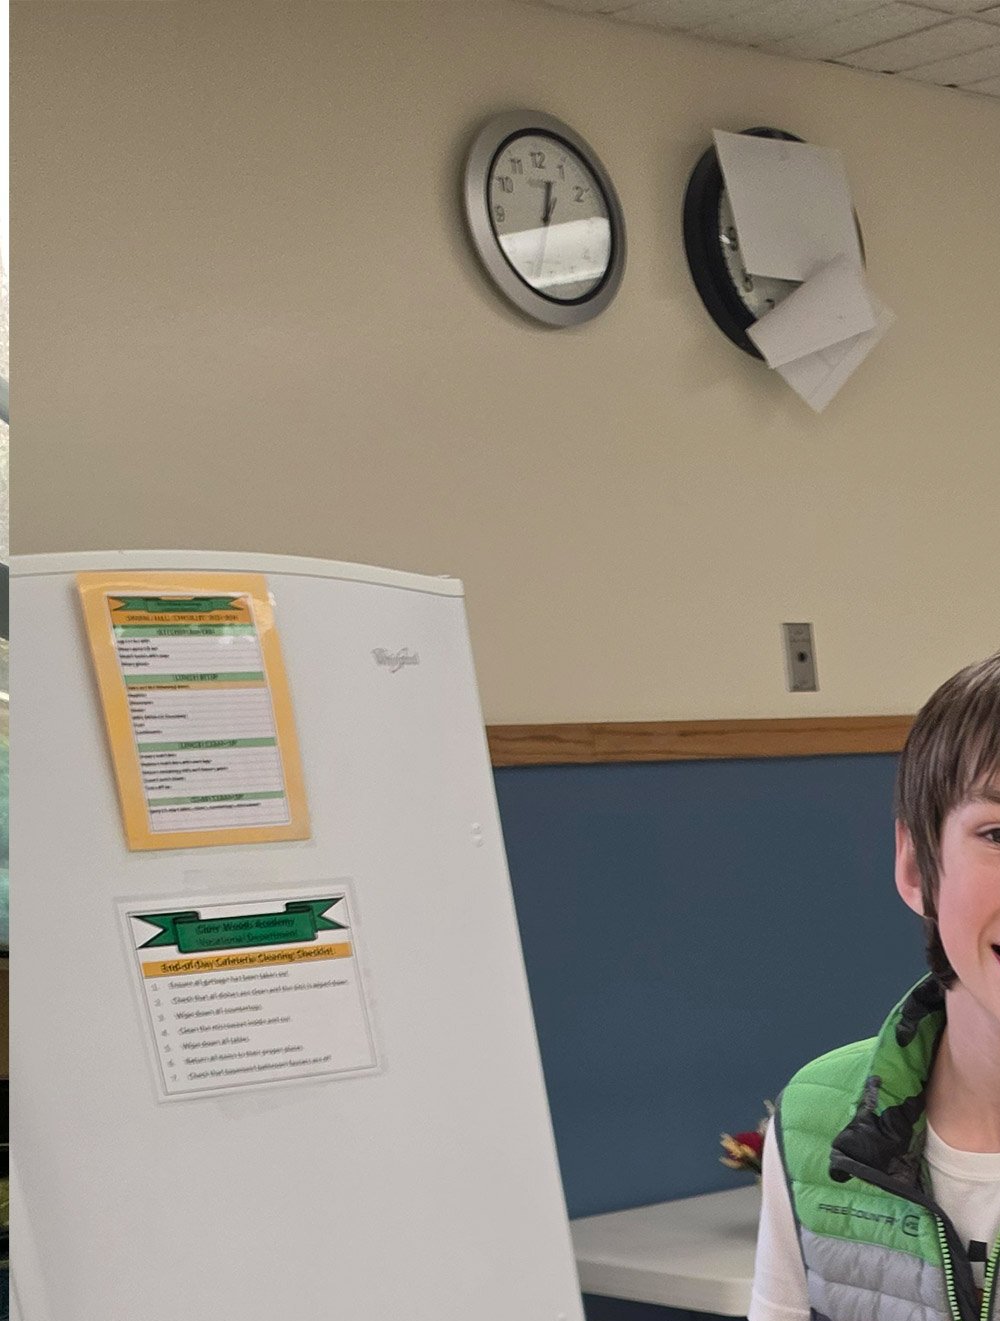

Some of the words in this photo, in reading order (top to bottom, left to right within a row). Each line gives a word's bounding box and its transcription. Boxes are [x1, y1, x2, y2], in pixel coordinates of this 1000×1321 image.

[509, 158, 523, 175] 11
[529, 151, 545, 169] 12
[496, 176, 514, 193] 10
[572, 186, 585, 203] 2
[254, 916, 295, 928] Academy
[246, 929, 298, 942] Department
[851, 1208, 900, 1226] COUNTRY
